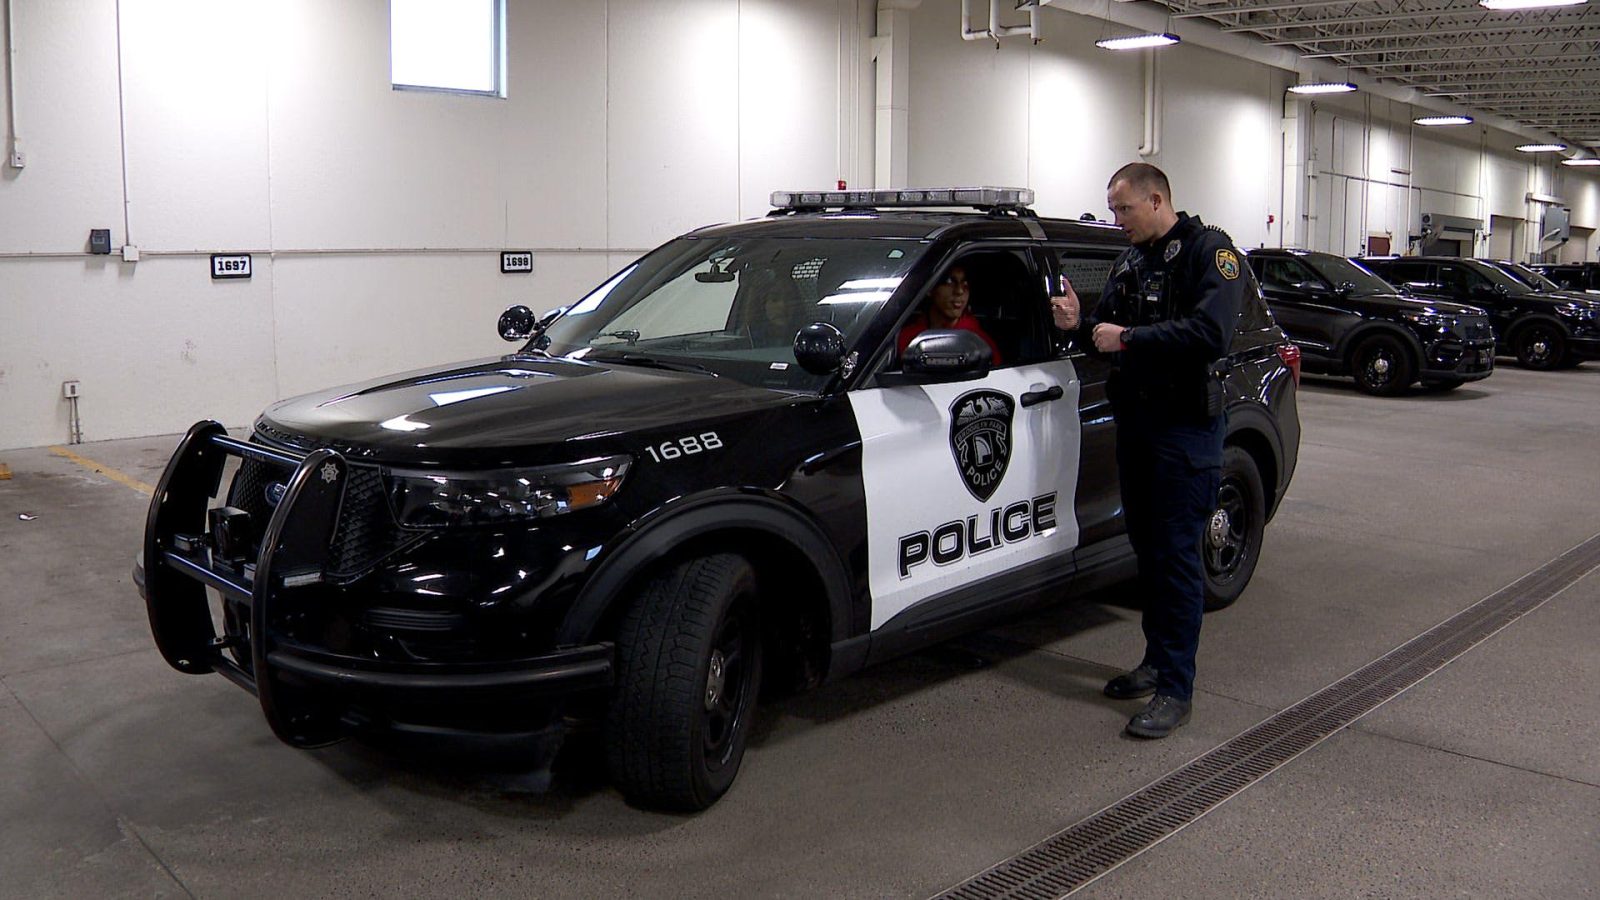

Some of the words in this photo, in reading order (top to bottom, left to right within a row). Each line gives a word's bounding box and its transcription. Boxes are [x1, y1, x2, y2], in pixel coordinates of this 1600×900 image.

[218, 260, 247, 271] 1697
[506, 257, 529, 266] 1698
[645, 431, 723, 463] 1688
[966, 458, 1004, 487] POLICE
[897, 491, 1058, 581] POLICE
